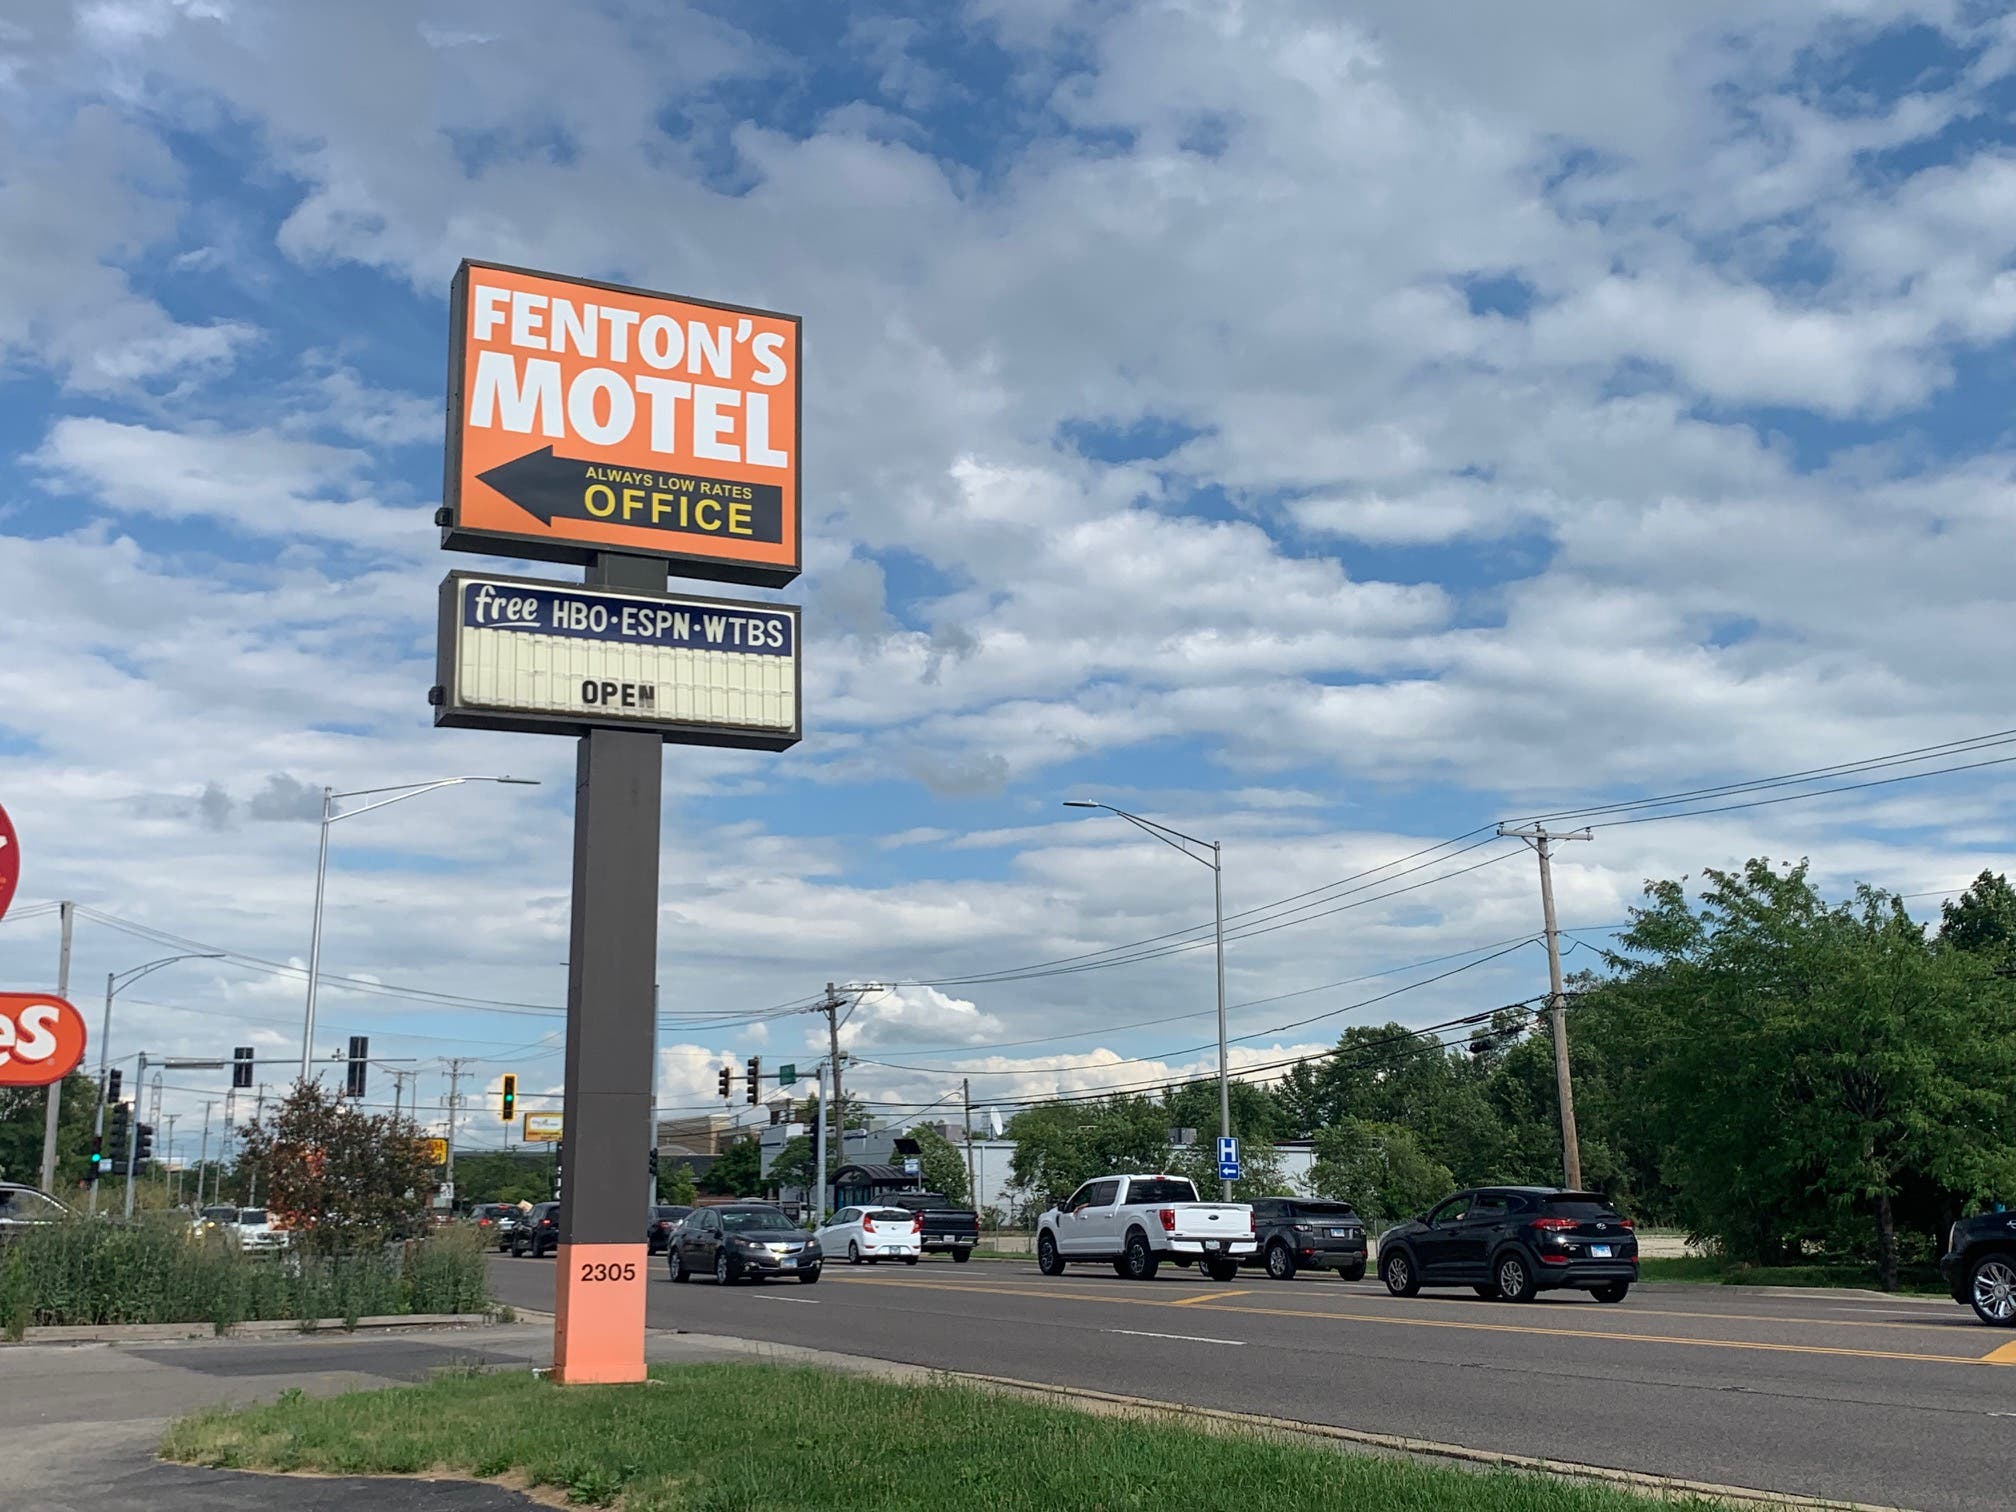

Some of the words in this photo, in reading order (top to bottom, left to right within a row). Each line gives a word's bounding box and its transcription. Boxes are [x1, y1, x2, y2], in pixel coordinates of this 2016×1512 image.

[472, 284, 788, 386] FENTON'S
[469, 350, 788, 468] MOTEL
[585, 467, 653, 487] ALWAYS
[659, 476, 695, 492] LOW
[700, 481, 752, 500] RATES
[584, 484, 752, 535] OFFICE
[475, 585, 539, 624] free
[581, 680, 655, 709] OPEN
[1220, 1139, 1236, 1162] H
[581, 1263, 635, 1281] 2305
